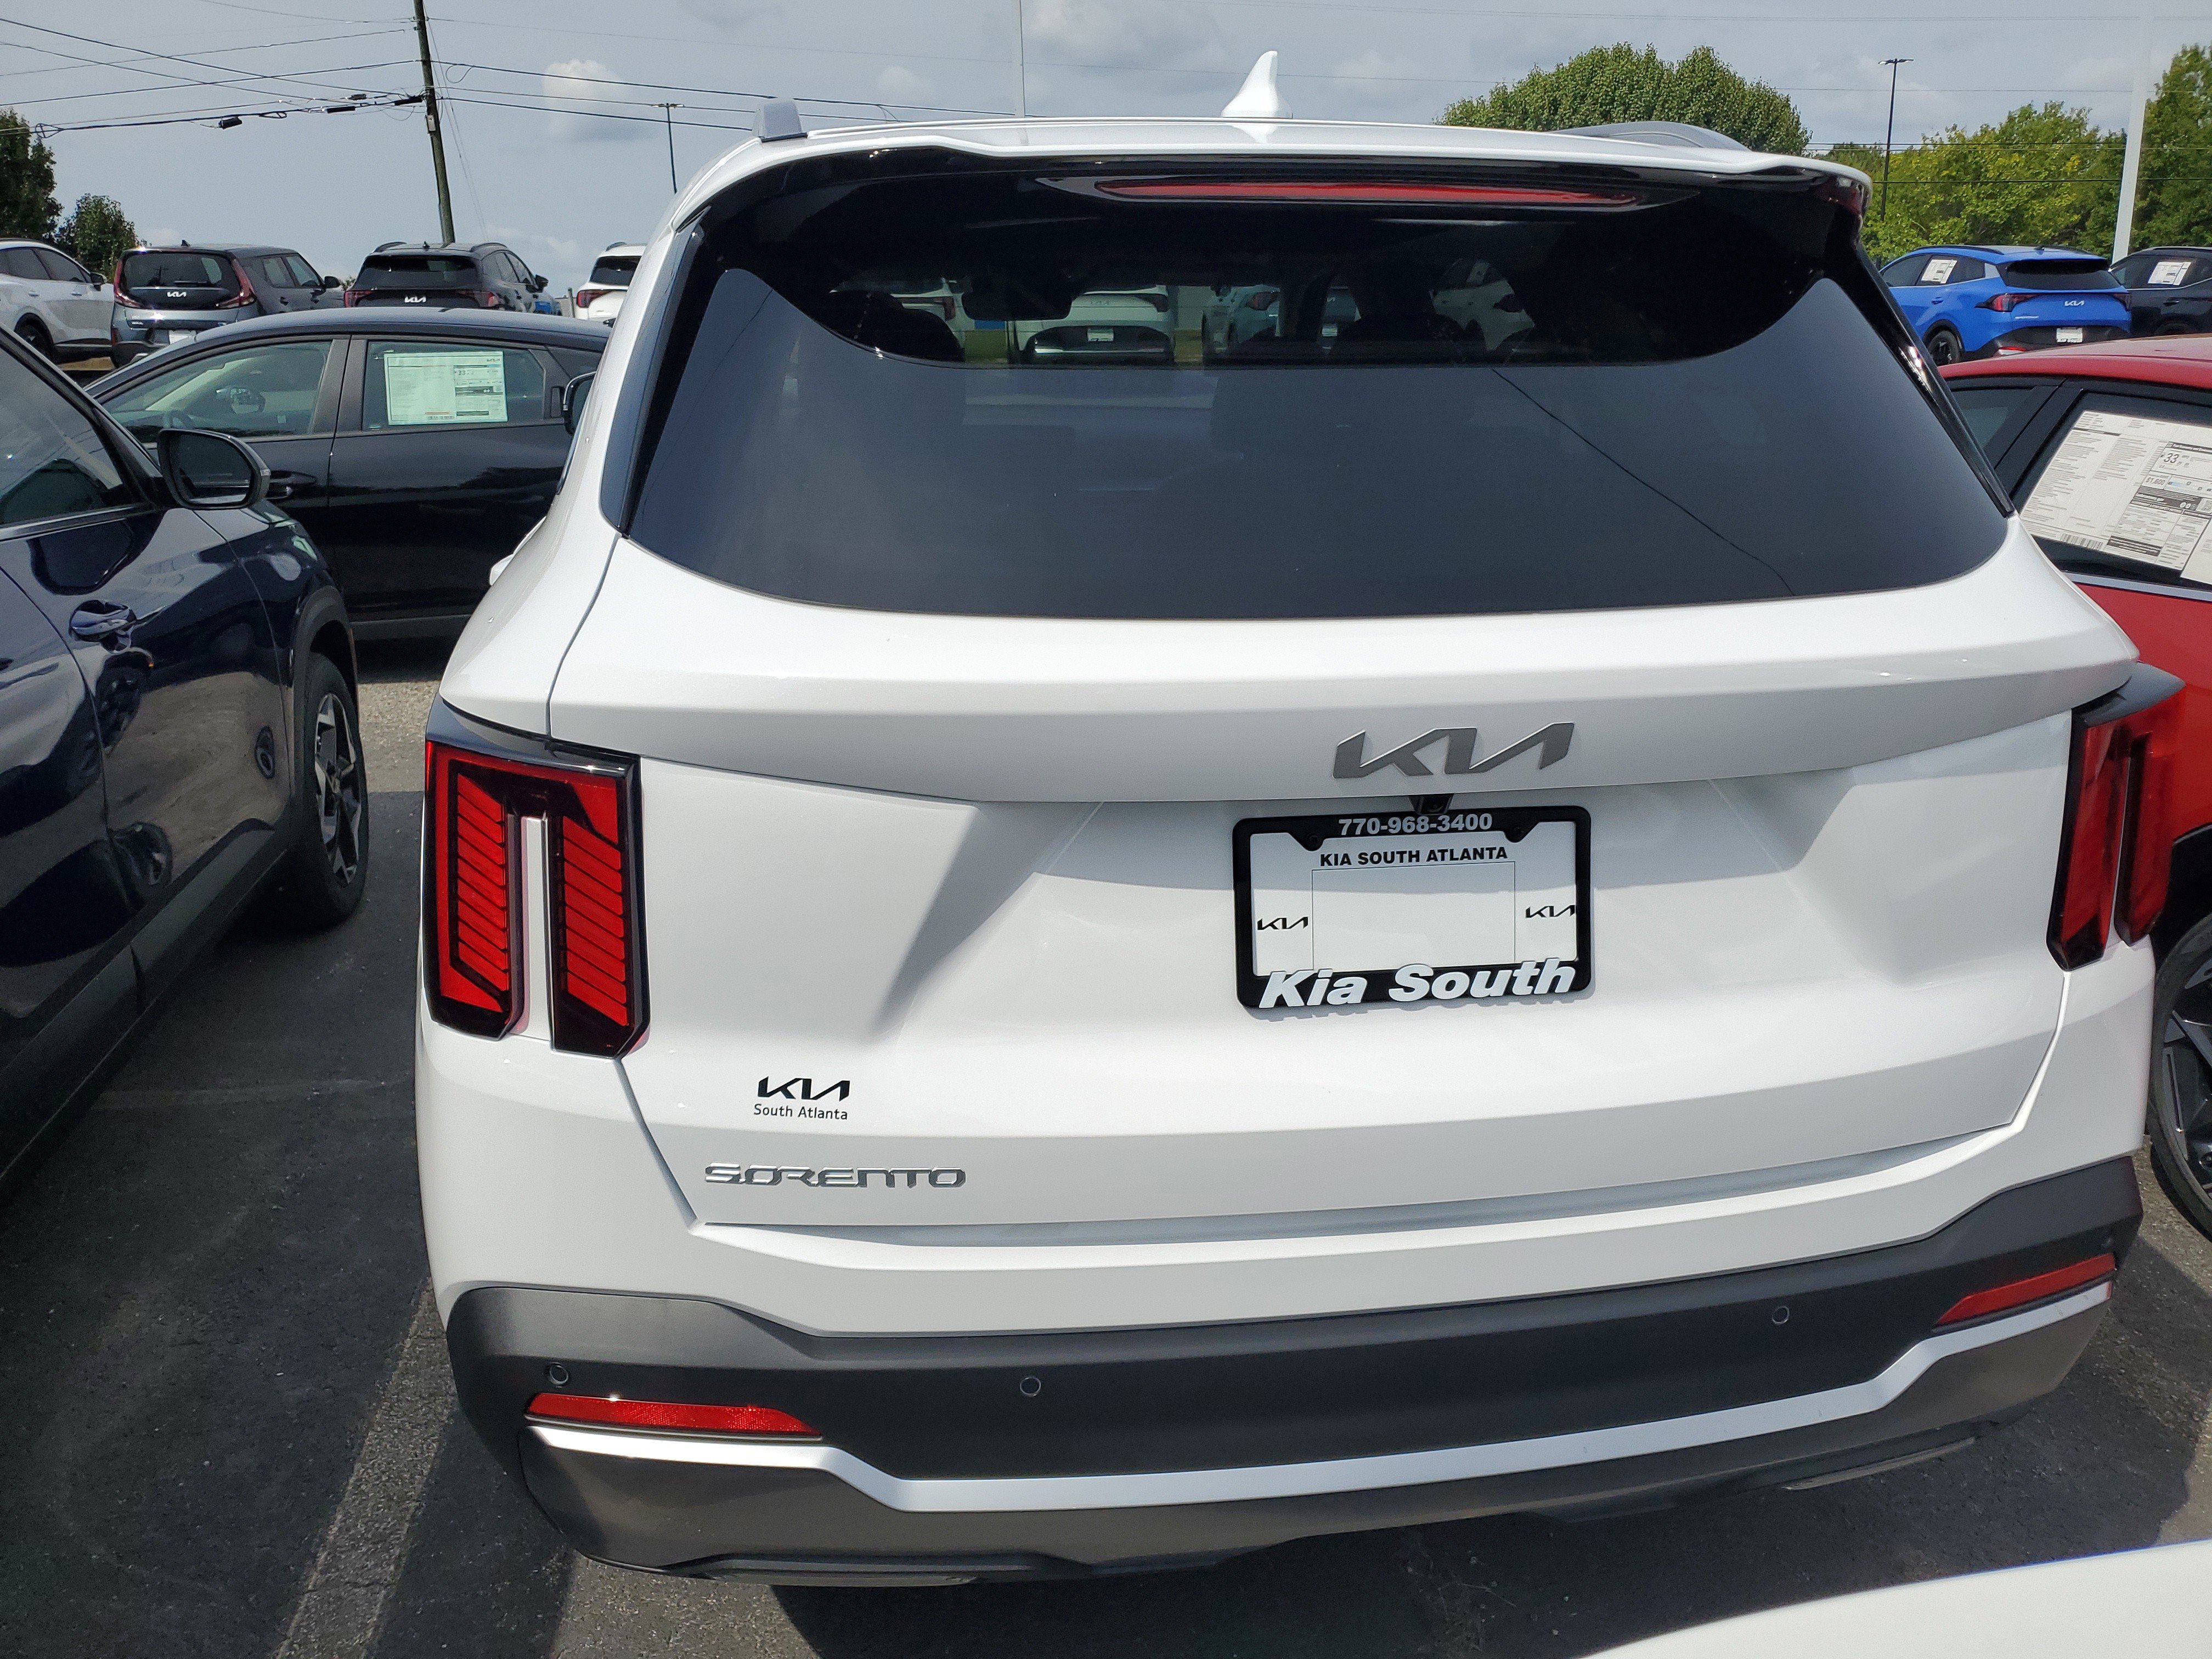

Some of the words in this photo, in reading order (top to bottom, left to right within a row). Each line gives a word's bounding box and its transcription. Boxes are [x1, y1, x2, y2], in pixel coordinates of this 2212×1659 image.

[2163, 453, 2180, 464] 33
[1333, 722, 1575, 778] KIA
[1338, 813, 1492, 836] 770-968-3400
[1320, 853, 1351, 867] KIA
[1358, 850, 1420, 865] SOUTH
[1426, 847, 1508, 862] ATLANTA
[1525, 905, 1575, 919] KIA
[1257, 916, 1308, 930] KIA
[1259, 968, 1368, 1009] Kia
[1388, 958, 1576, 1002] South
[757, 1076, 850, 1102] KIA
[753, 1103, 793, 1118] South
[798, 1106, 848, 1120] Atlanta
[705, 1163, 967, 1189] SORENTO
